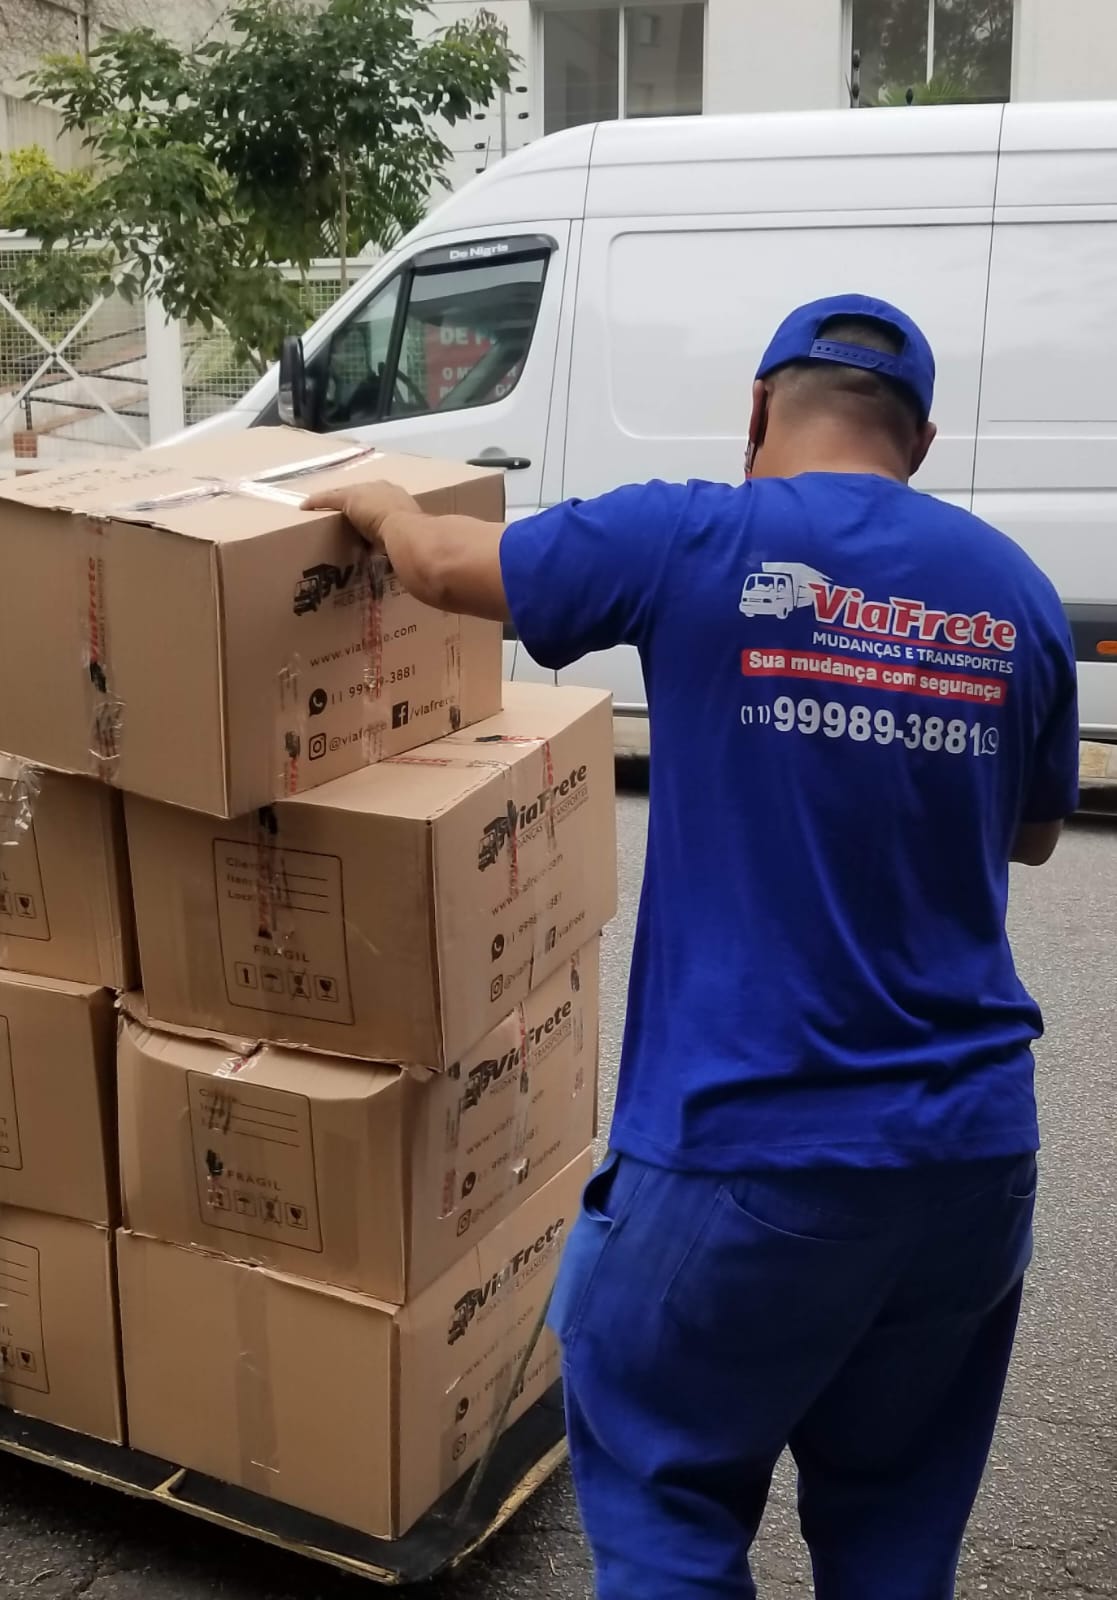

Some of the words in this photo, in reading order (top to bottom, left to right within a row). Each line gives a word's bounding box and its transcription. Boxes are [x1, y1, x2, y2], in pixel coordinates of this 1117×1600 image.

[450, 249, 468, 260] De
[808, 582, 1017, 651] ViaFrete
[749, 651, 785, 669] Sua
[790, 655, 878, 683] mudança
[882, 670, 916, 687] com
[919, 676, 1002, 701] segurança
[812, 631, 901, 658] MUDANÇAS
[904, 646, 914, 660] E
[915, 648, 1014, 674] TRANSPORTES
[740, 704, 771, 726] (11)
[773, 696, 981, 757] 99989-3881
